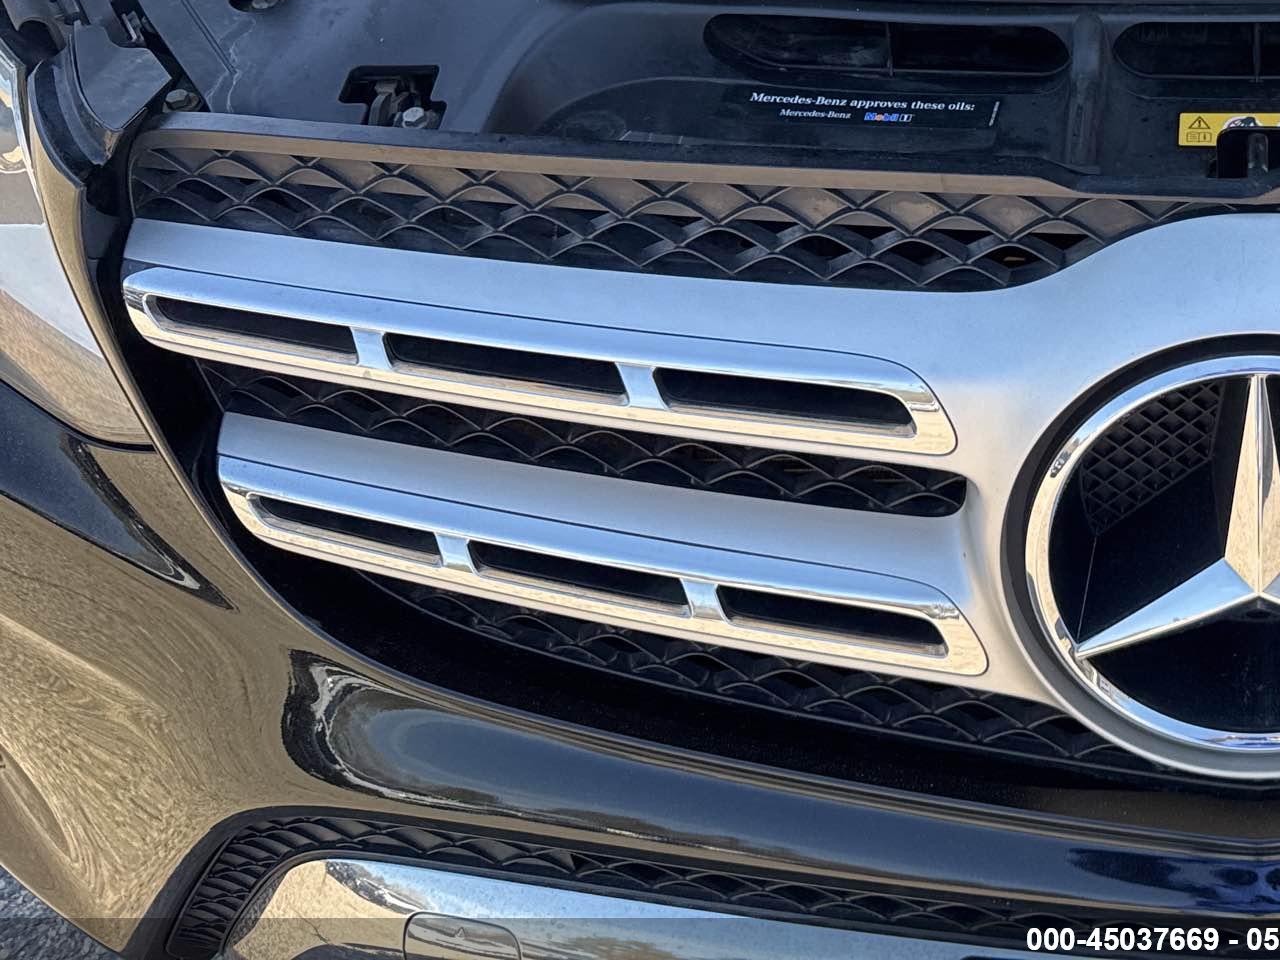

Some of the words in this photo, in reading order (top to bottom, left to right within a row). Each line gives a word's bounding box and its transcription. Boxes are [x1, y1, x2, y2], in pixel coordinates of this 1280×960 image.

[749, 92, 847, 107] Mercedes-Benz
[849, 99, 908, 109] approves
[911, 100, 946, 111] these
[948, 101, 976, 112] oils:
[779, 109, 852, 119] Mercedes-Benz
[864, 112, 900, 122] Mobil
